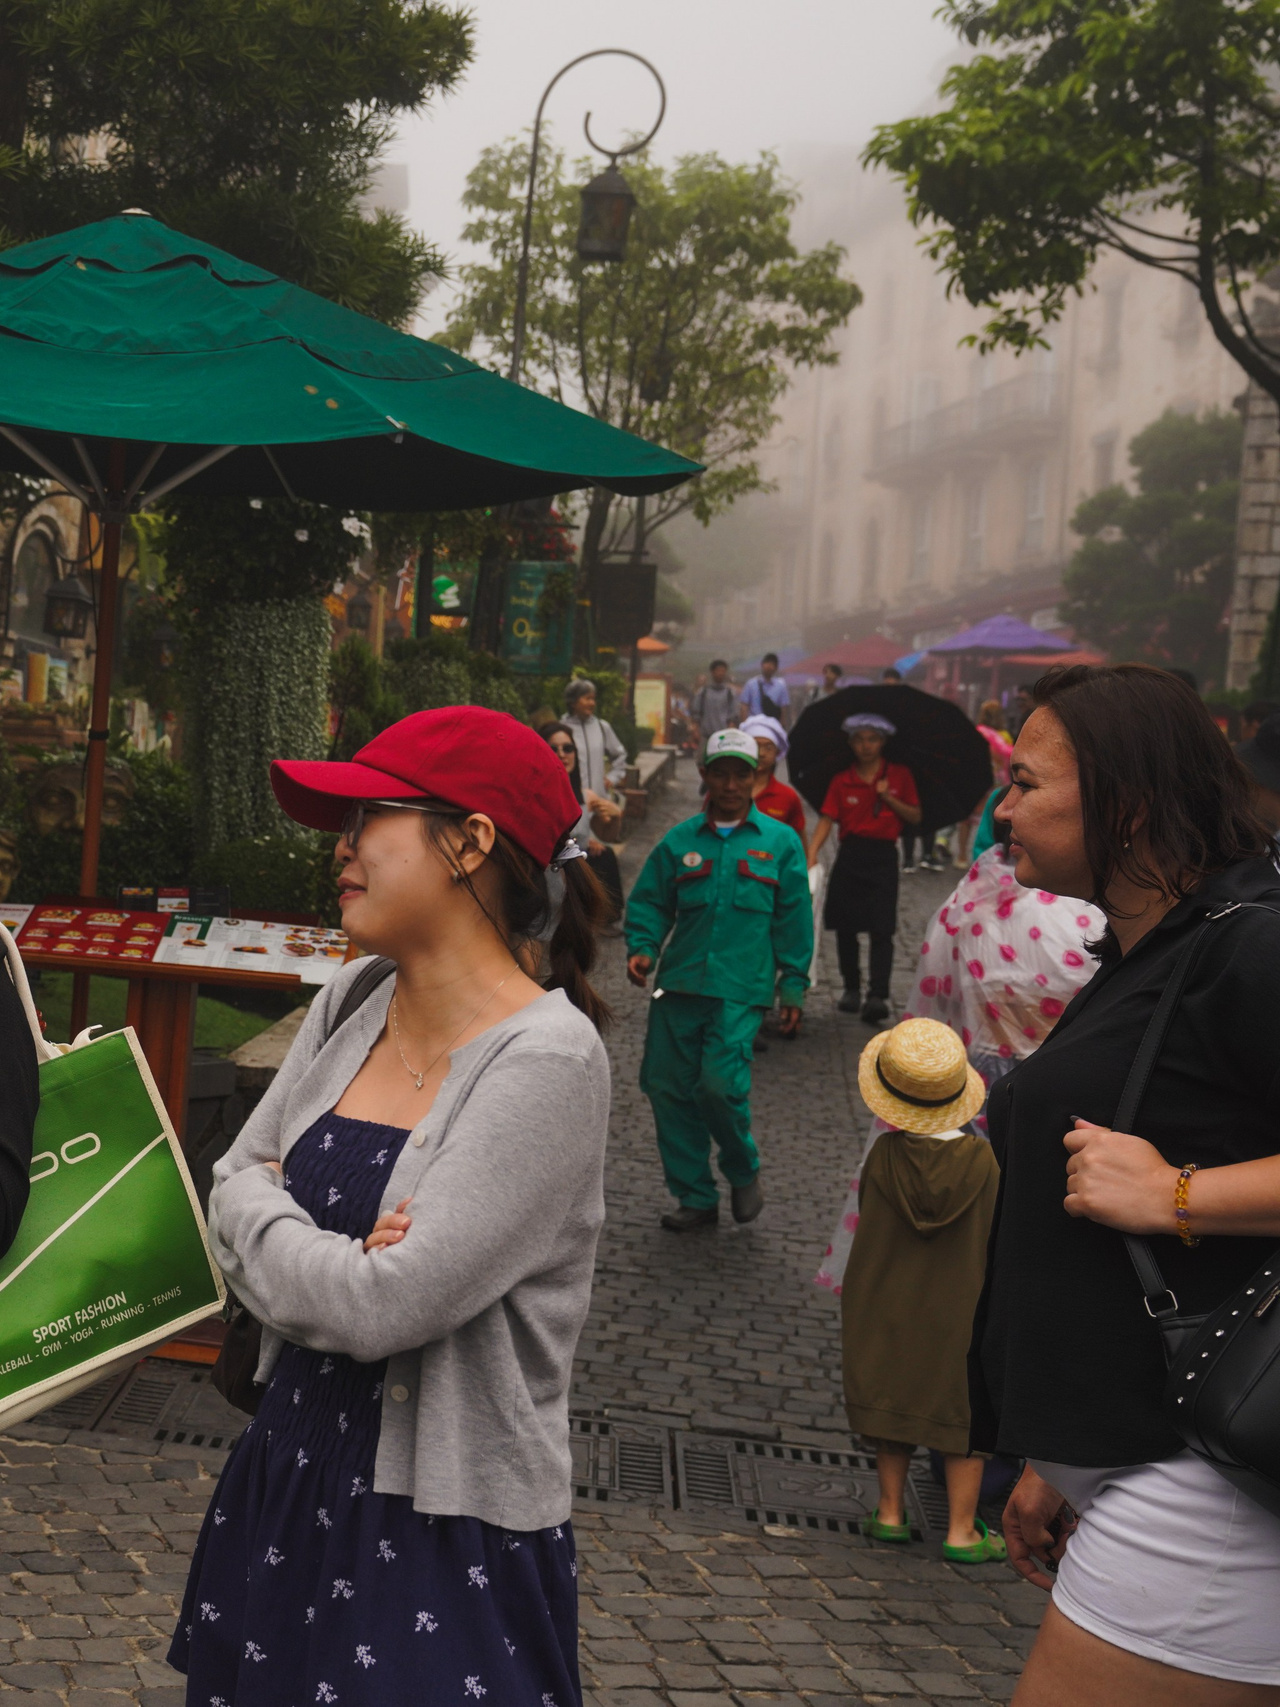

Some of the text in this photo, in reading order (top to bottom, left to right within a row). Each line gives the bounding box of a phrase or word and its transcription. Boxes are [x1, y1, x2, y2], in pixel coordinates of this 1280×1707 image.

[32, 1291, 128, 1344] SPORT FASHION
[41, 1341, 62, 1358] GYM
[70, 1326, 94, 1344] YOGA
[100, 1303, 145, 1330] RUNNING
[152, 1286, 182, 1307] TENNIS
